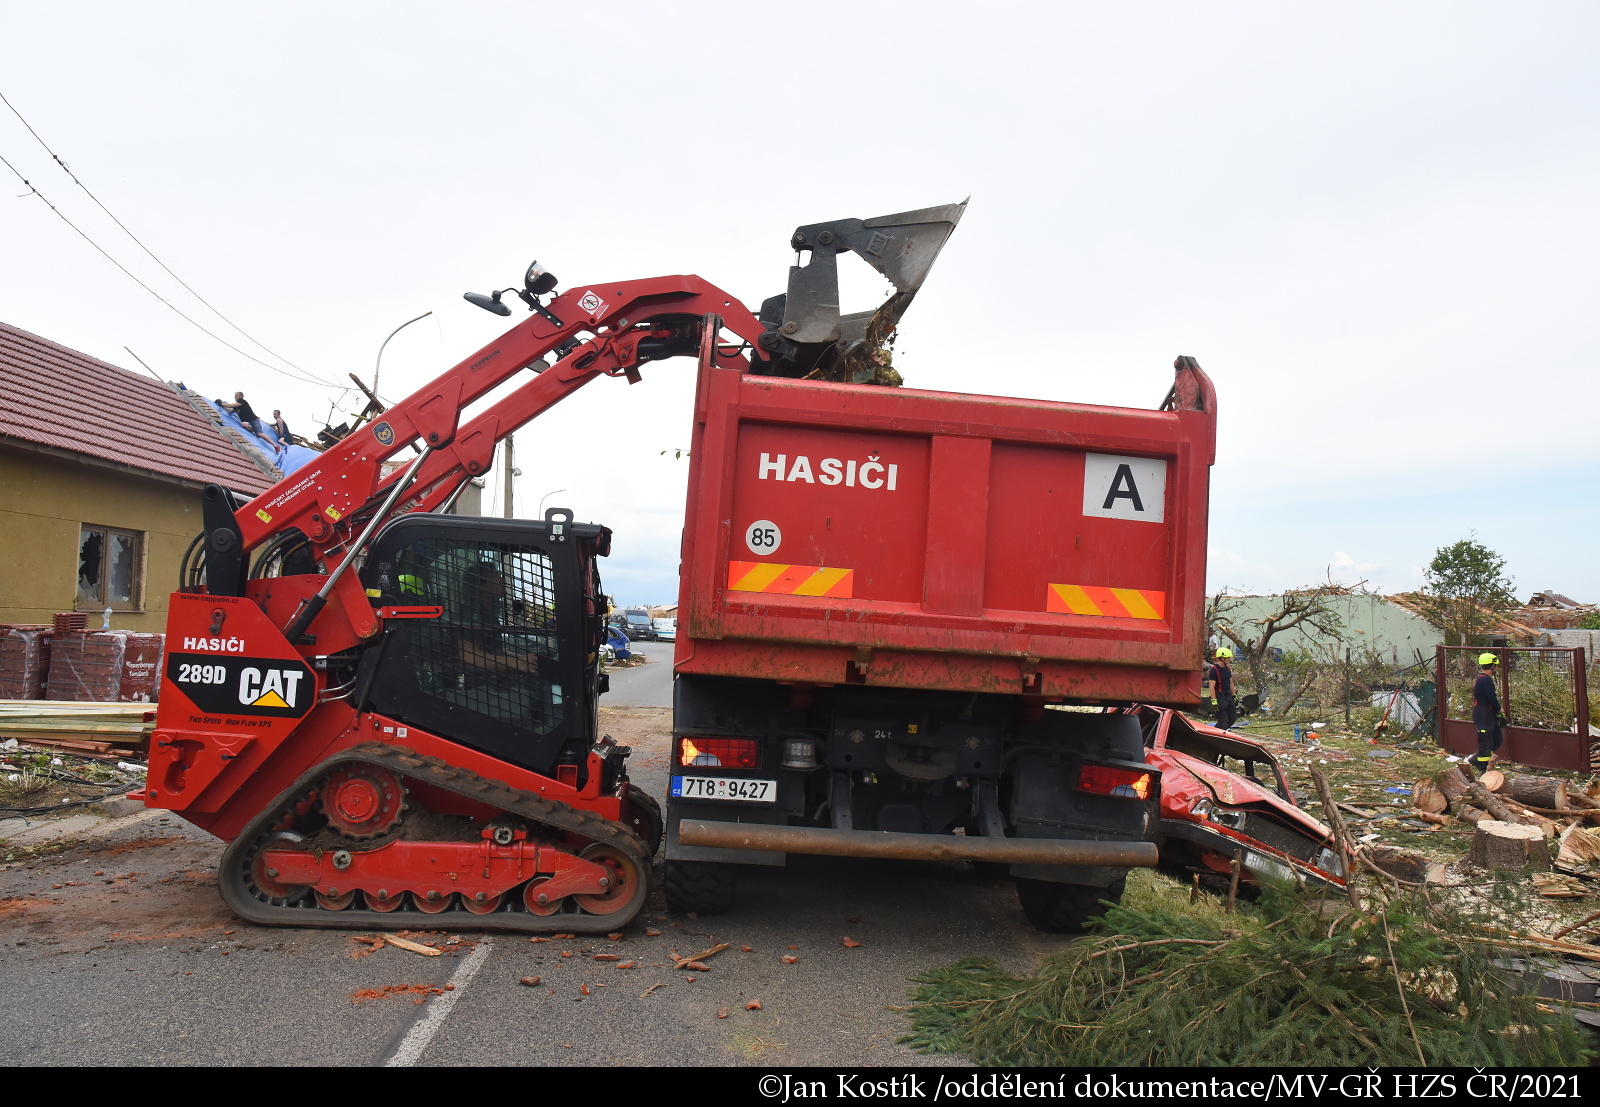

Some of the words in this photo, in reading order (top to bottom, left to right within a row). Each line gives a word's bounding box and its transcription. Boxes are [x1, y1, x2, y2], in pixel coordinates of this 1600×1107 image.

[470, 349, 500, 371] ZEPPELIN
[758, 452, 898, 491] HASIČI
[1102, 464, 1145, 511] A
[751, 528, 775, 547] 85
[180, 594, 239, 604] www.zeppelin.cz
[183, 636, 245, 653] HASIČI
[178, 663, 227, 685] 289D
[238, 667, 303, 708] CAT
[874, 729, 886, 739] 24
[686, 778, 715, 797] 7T8
[728, 781, 769, 799] 9427
